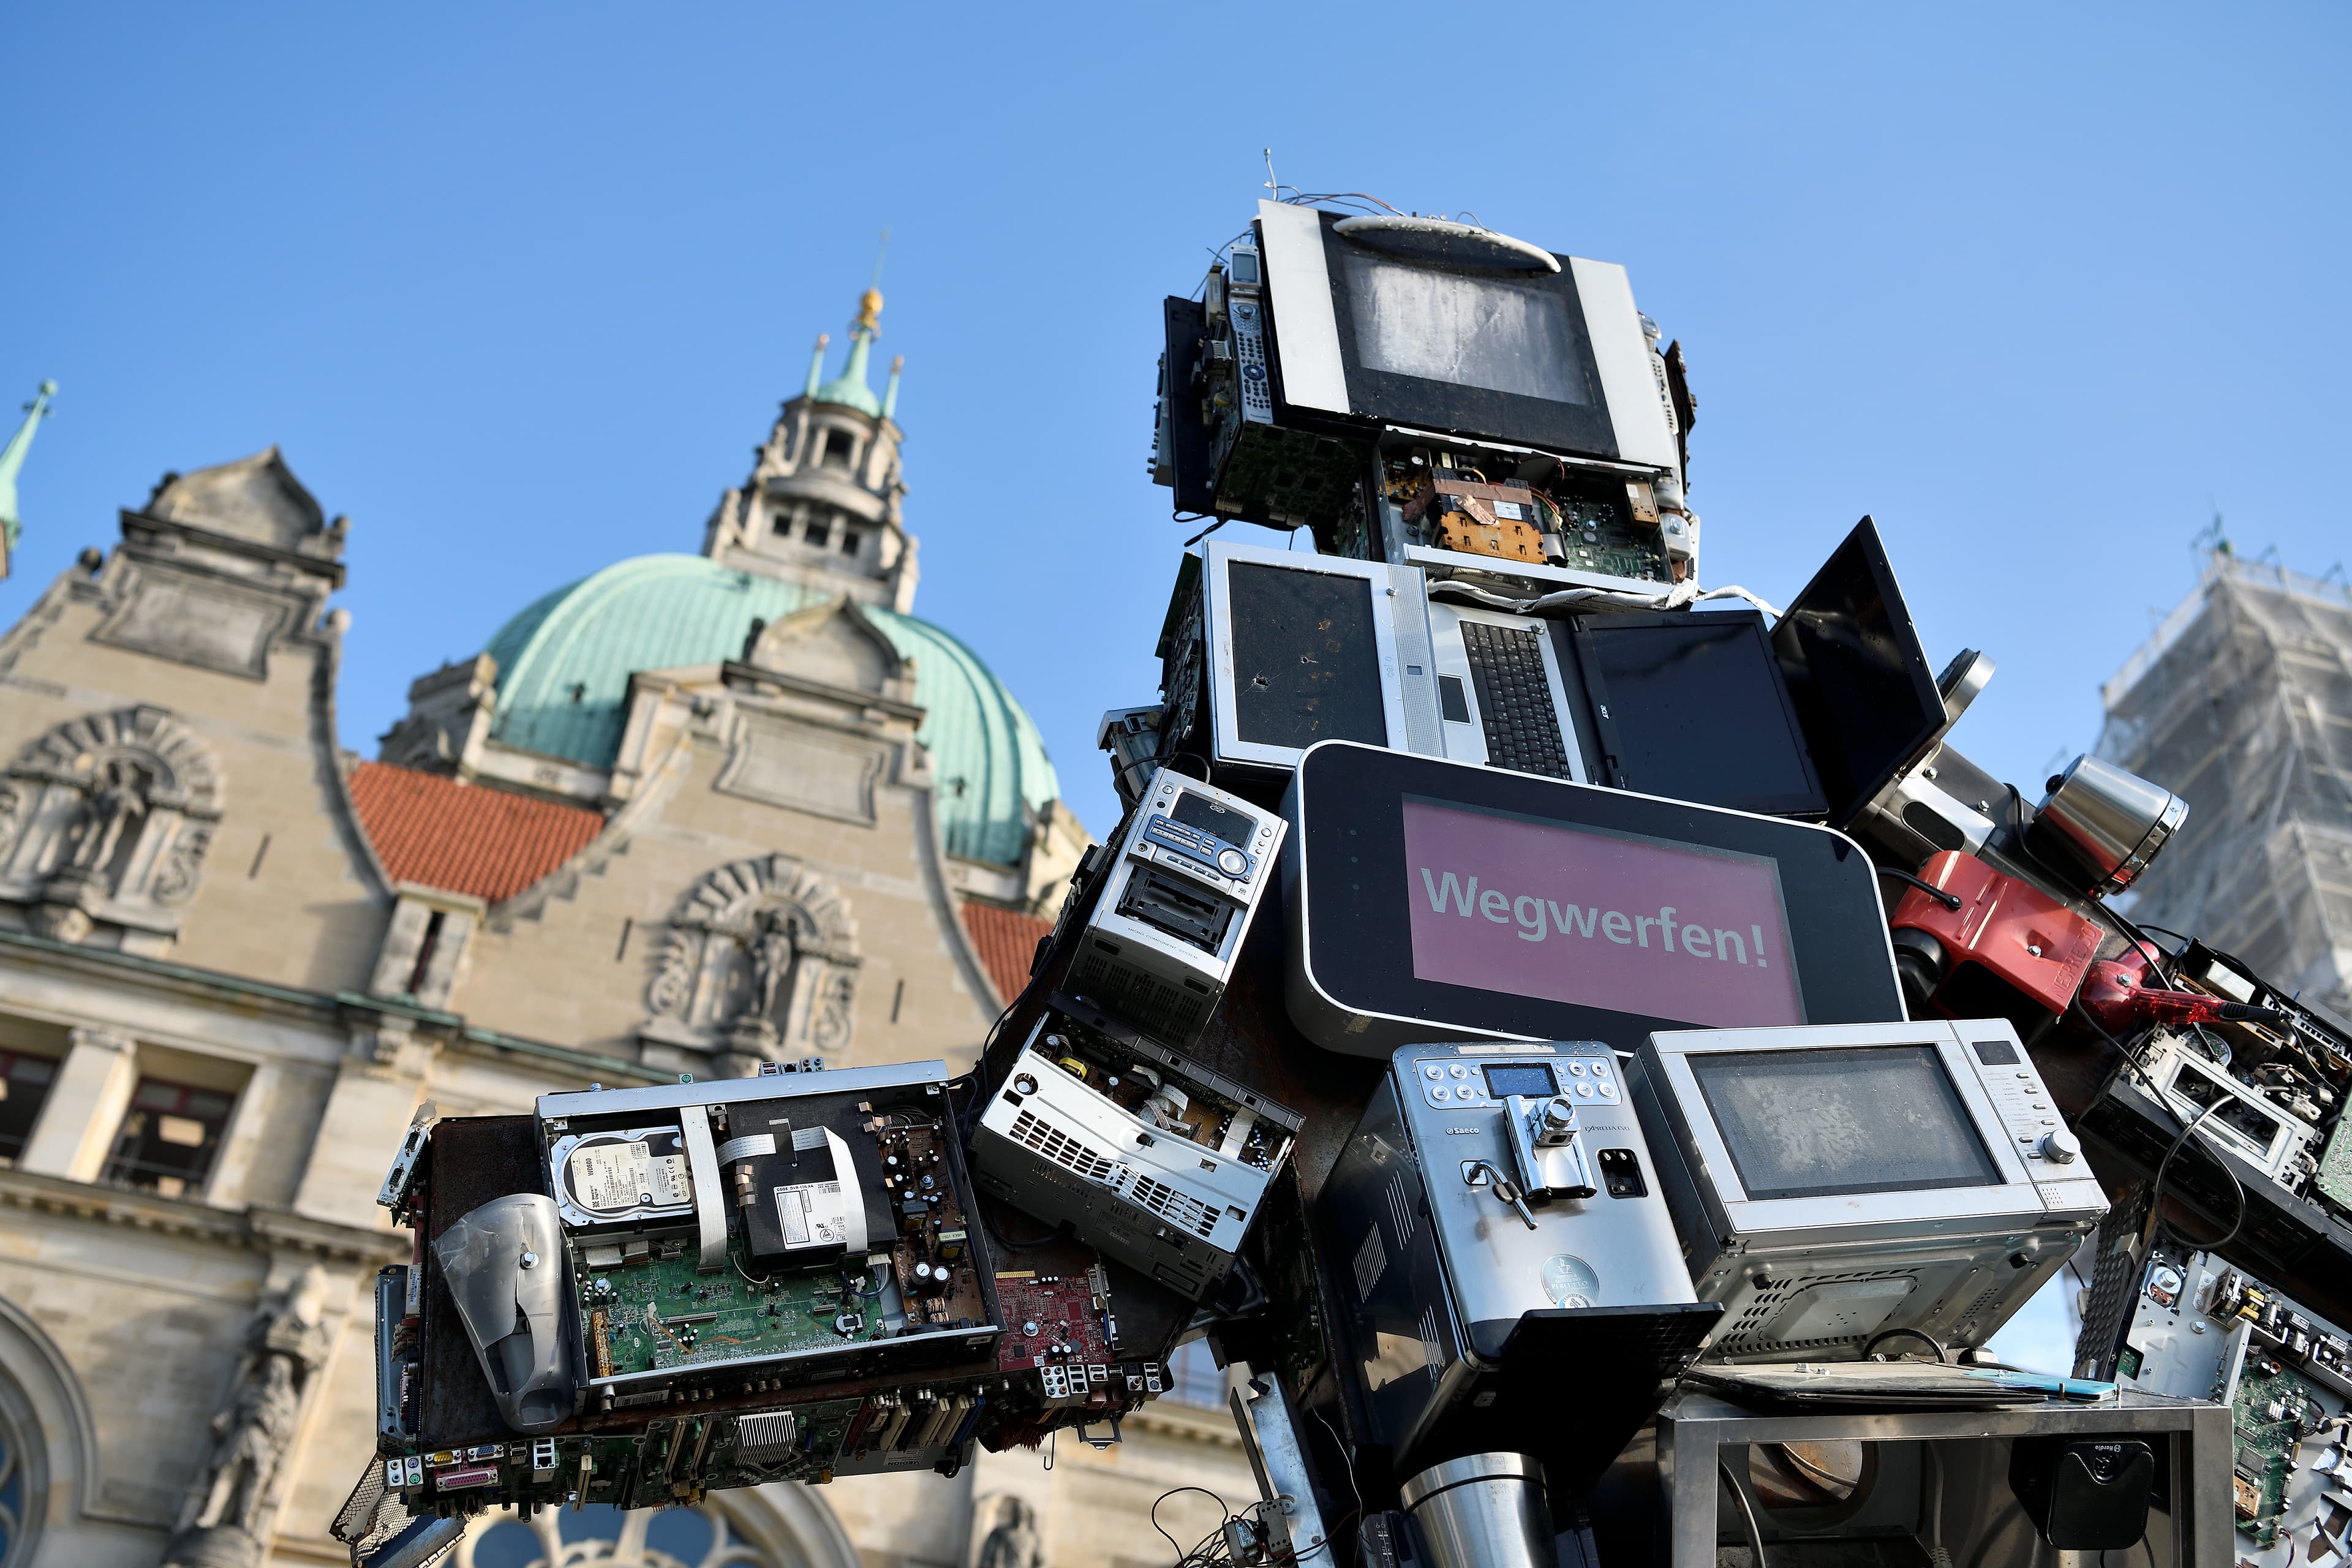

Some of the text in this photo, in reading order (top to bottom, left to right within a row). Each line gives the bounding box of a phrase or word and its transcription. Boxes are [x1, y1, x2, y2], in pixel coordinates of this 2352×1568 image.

[1128, 927, 1198, 960] MICRO COMPONENT SYSTEM
[1420, 867, 1768, 968] Wegwerfen!
[2051, 926, 2098, 999] NESPRESSO
[586, 1158, 594, 1176] WD800
